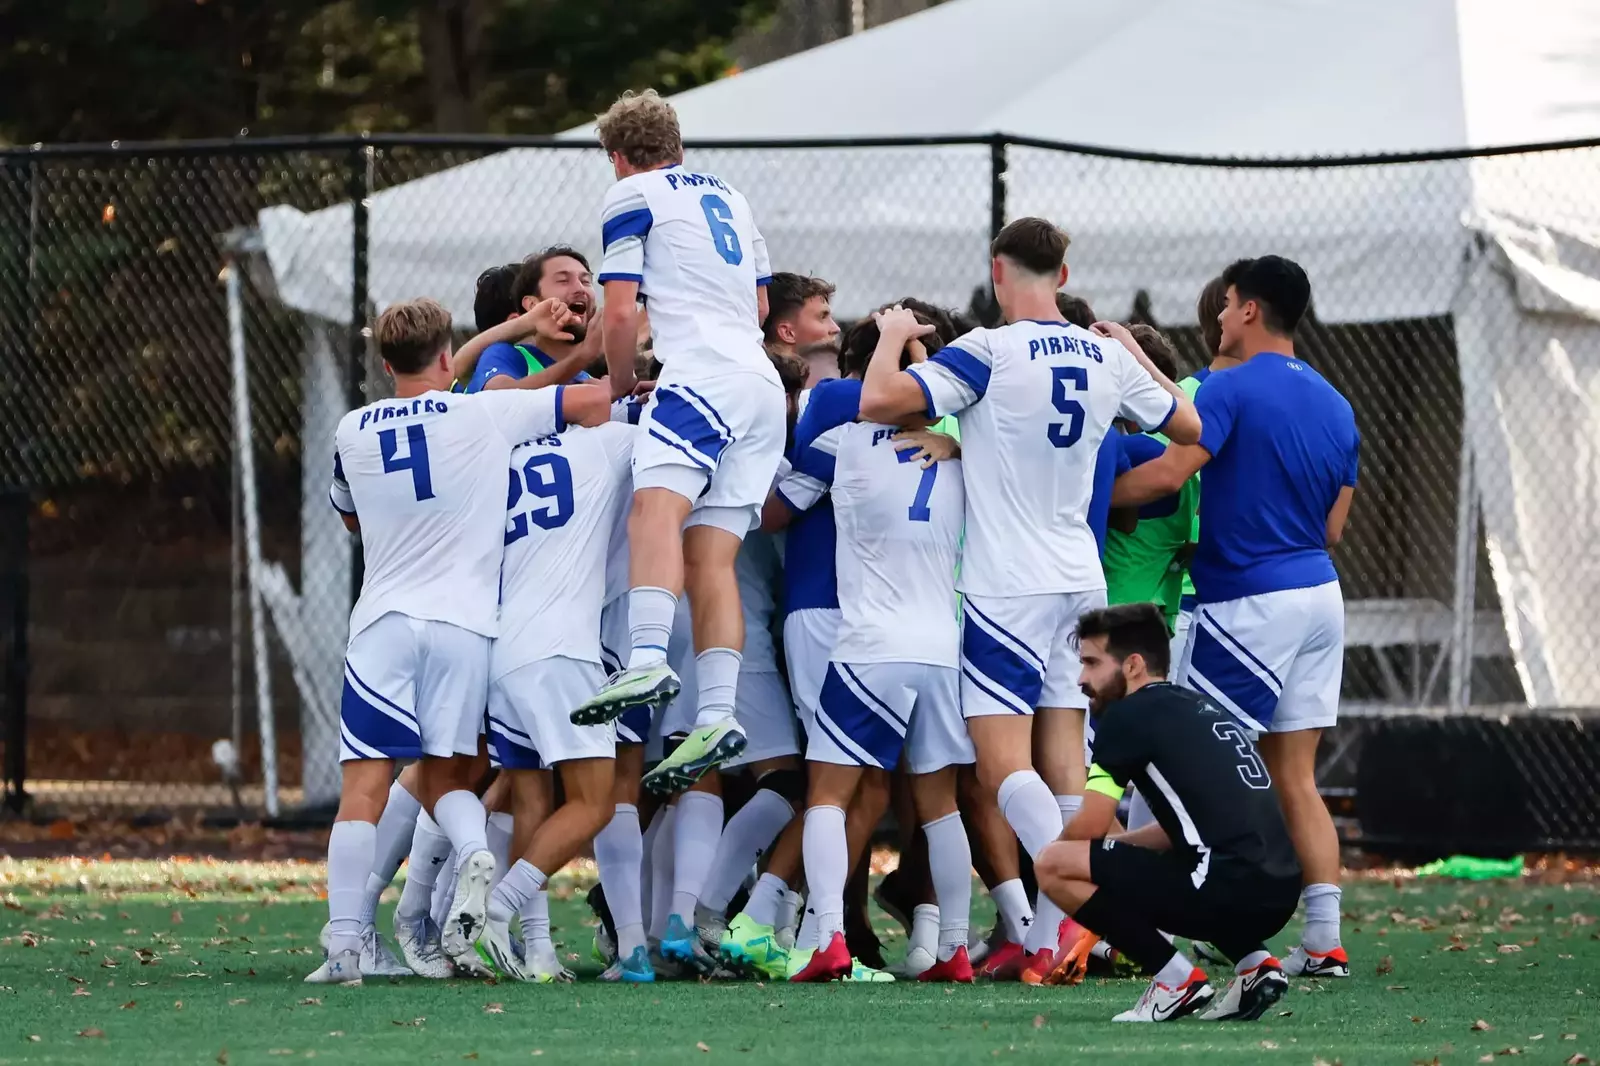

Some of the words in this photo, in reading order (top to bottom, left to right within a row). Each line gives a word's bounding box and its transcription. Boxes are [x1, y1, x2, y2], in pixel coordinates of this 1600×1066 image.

[699, 194, 743, 266] 6
[1028, 336, 1103, 364] PIRATES
[1047, 367, 1088, 448] 5
[376, 423, 436, 502] 4
[504, 452, 574, 547] 29
[894, 446, 938, 522] 7
[1212, 721, 1271, 789] 3
